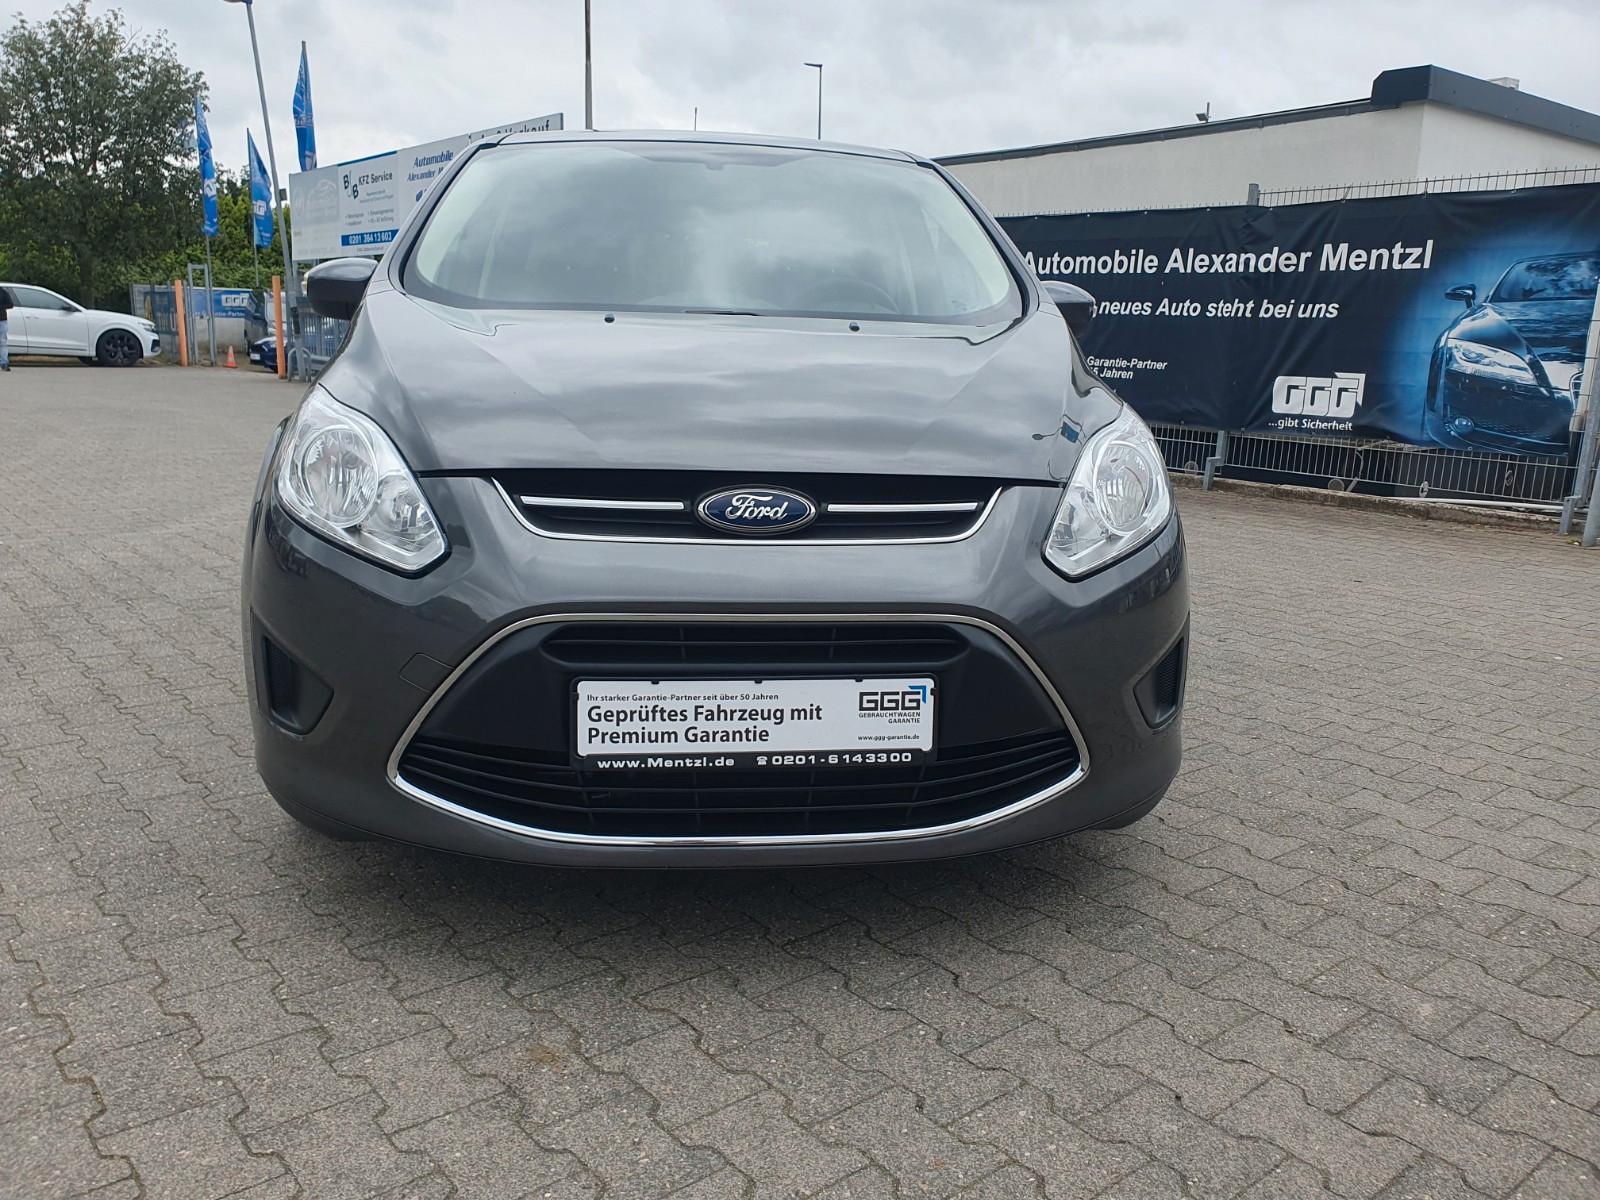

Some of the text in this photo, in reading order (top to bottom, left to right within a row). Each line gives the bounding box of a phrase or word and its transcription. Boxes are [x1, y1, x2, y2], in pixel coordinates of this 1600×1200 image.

[413, 150, 454, 168] Automobile
[358, 171, 393, 186] KFZ Service
[407, 169, 436, 182] Alexander
[1023, 239, 1434, 275] Automobile Alexander Mentzl
[1098, 298, 1340, 319] neues Auto steht bei uns
[1087, 356, 1168, 370] Garantie-Partner
[1100, 368, 1134, 380] Jahren
[1271, 375, 1360, 418] GGG
[1301, 418, 1353, 431] Sicherheit
[725, 494, 789, 520] Ford
[858, 690, 921, 712] GGG
[587, 703, 823, 726] Geprüftes Fahrzeug mit
[858, 711, 921, 719] GEBRAUCHTWAGEN
[588, 725, 770, 744] Premium Garantie
[597, 756, 735, 769] www.Mentzl.de
